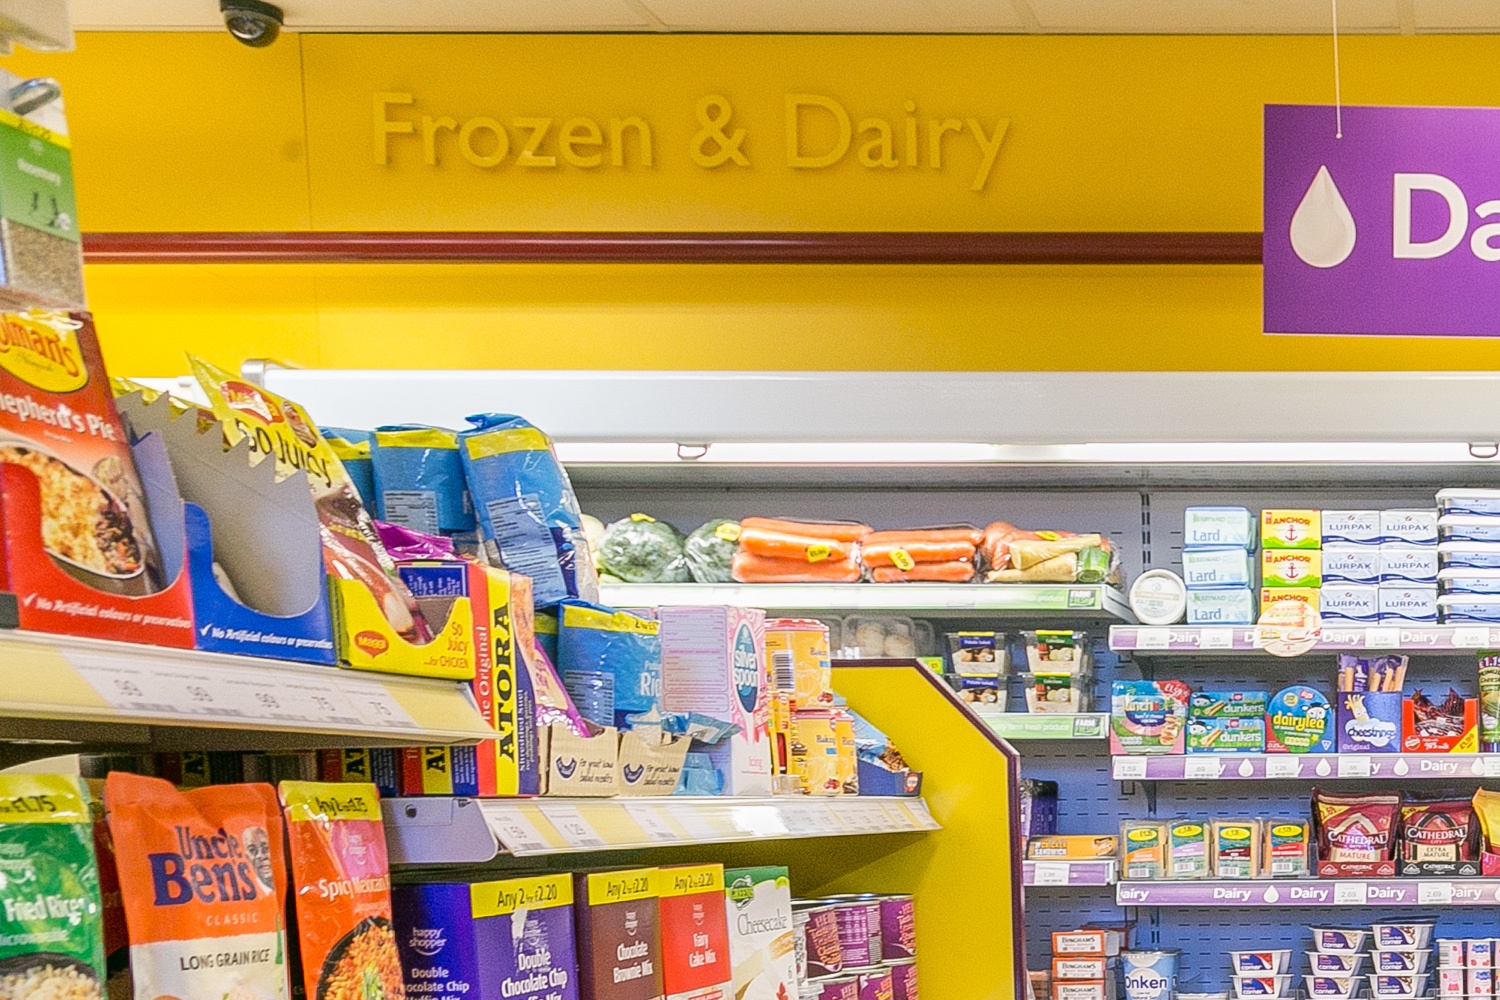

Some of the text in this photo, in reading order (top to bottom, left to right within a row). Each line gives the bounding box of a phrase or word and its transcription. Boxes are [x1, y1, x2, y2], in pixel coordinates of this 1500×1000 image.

[372, 91, 1013, 192] Frozen & Dairy
[1273, 515, 1310, 526] ANCHOR
[1329, 523, 1372, 532] LURPAK
[1386, 524, 1429, 532] LURPAK
[1193, 529, 1220, 542] Lard
[1328, 562, 1371, 570] LURPAK
[1388, 561, 1429, 570] LURPAK
[1189, 569, 1217, 582] Lard
[1194, 608, 1221, 621] Lard
[358, 635, 385, 650] Maggi
[447, 636, 468, 655] Juicy
[476, 625, 491, 695] Original
[734, 650, 757, 669] silver
[495, 603, 514, 763] ATORA
[734, 668, 759, 687] spoon
[1224, 704, 1264, 713] dunkers
[1273, 715, 1324, 731] dairylea
[1220, 732, 1261, 742] dunkers
[1328, 829, 1389, 845] CATHEDRAL
[1407, 828, 1467, 842] CATHEDRAL
[176, 826, 240, 860] Uncle
[1339, 852, 1370, 860] MATURE
[148, 852, 257, 906] Ben's
[1213, 886, 1251, 901] Dairy
[206, 914, 258, 926] CLASSIC
[737, 912, 787, 936] Cheesecake
[413, 928, 443, 940] happy
[693, 931, 709, 951] Fairy
[409, 936, 447, 949] shopper
[617, 941, 648, 961] Chocolate
[688, 949, 716, 968] Cake Mix
[180, 949, 270, 970] LONG GRAIN RICE
[518, 950, 551, 971] Double
[412, 967, 448, 978] Double
[613, 960, 653, 984] Brownie Mix
[502, 968, 568, 998] Chocolate Chip
[1124, 975, 1169, 990] Onken
